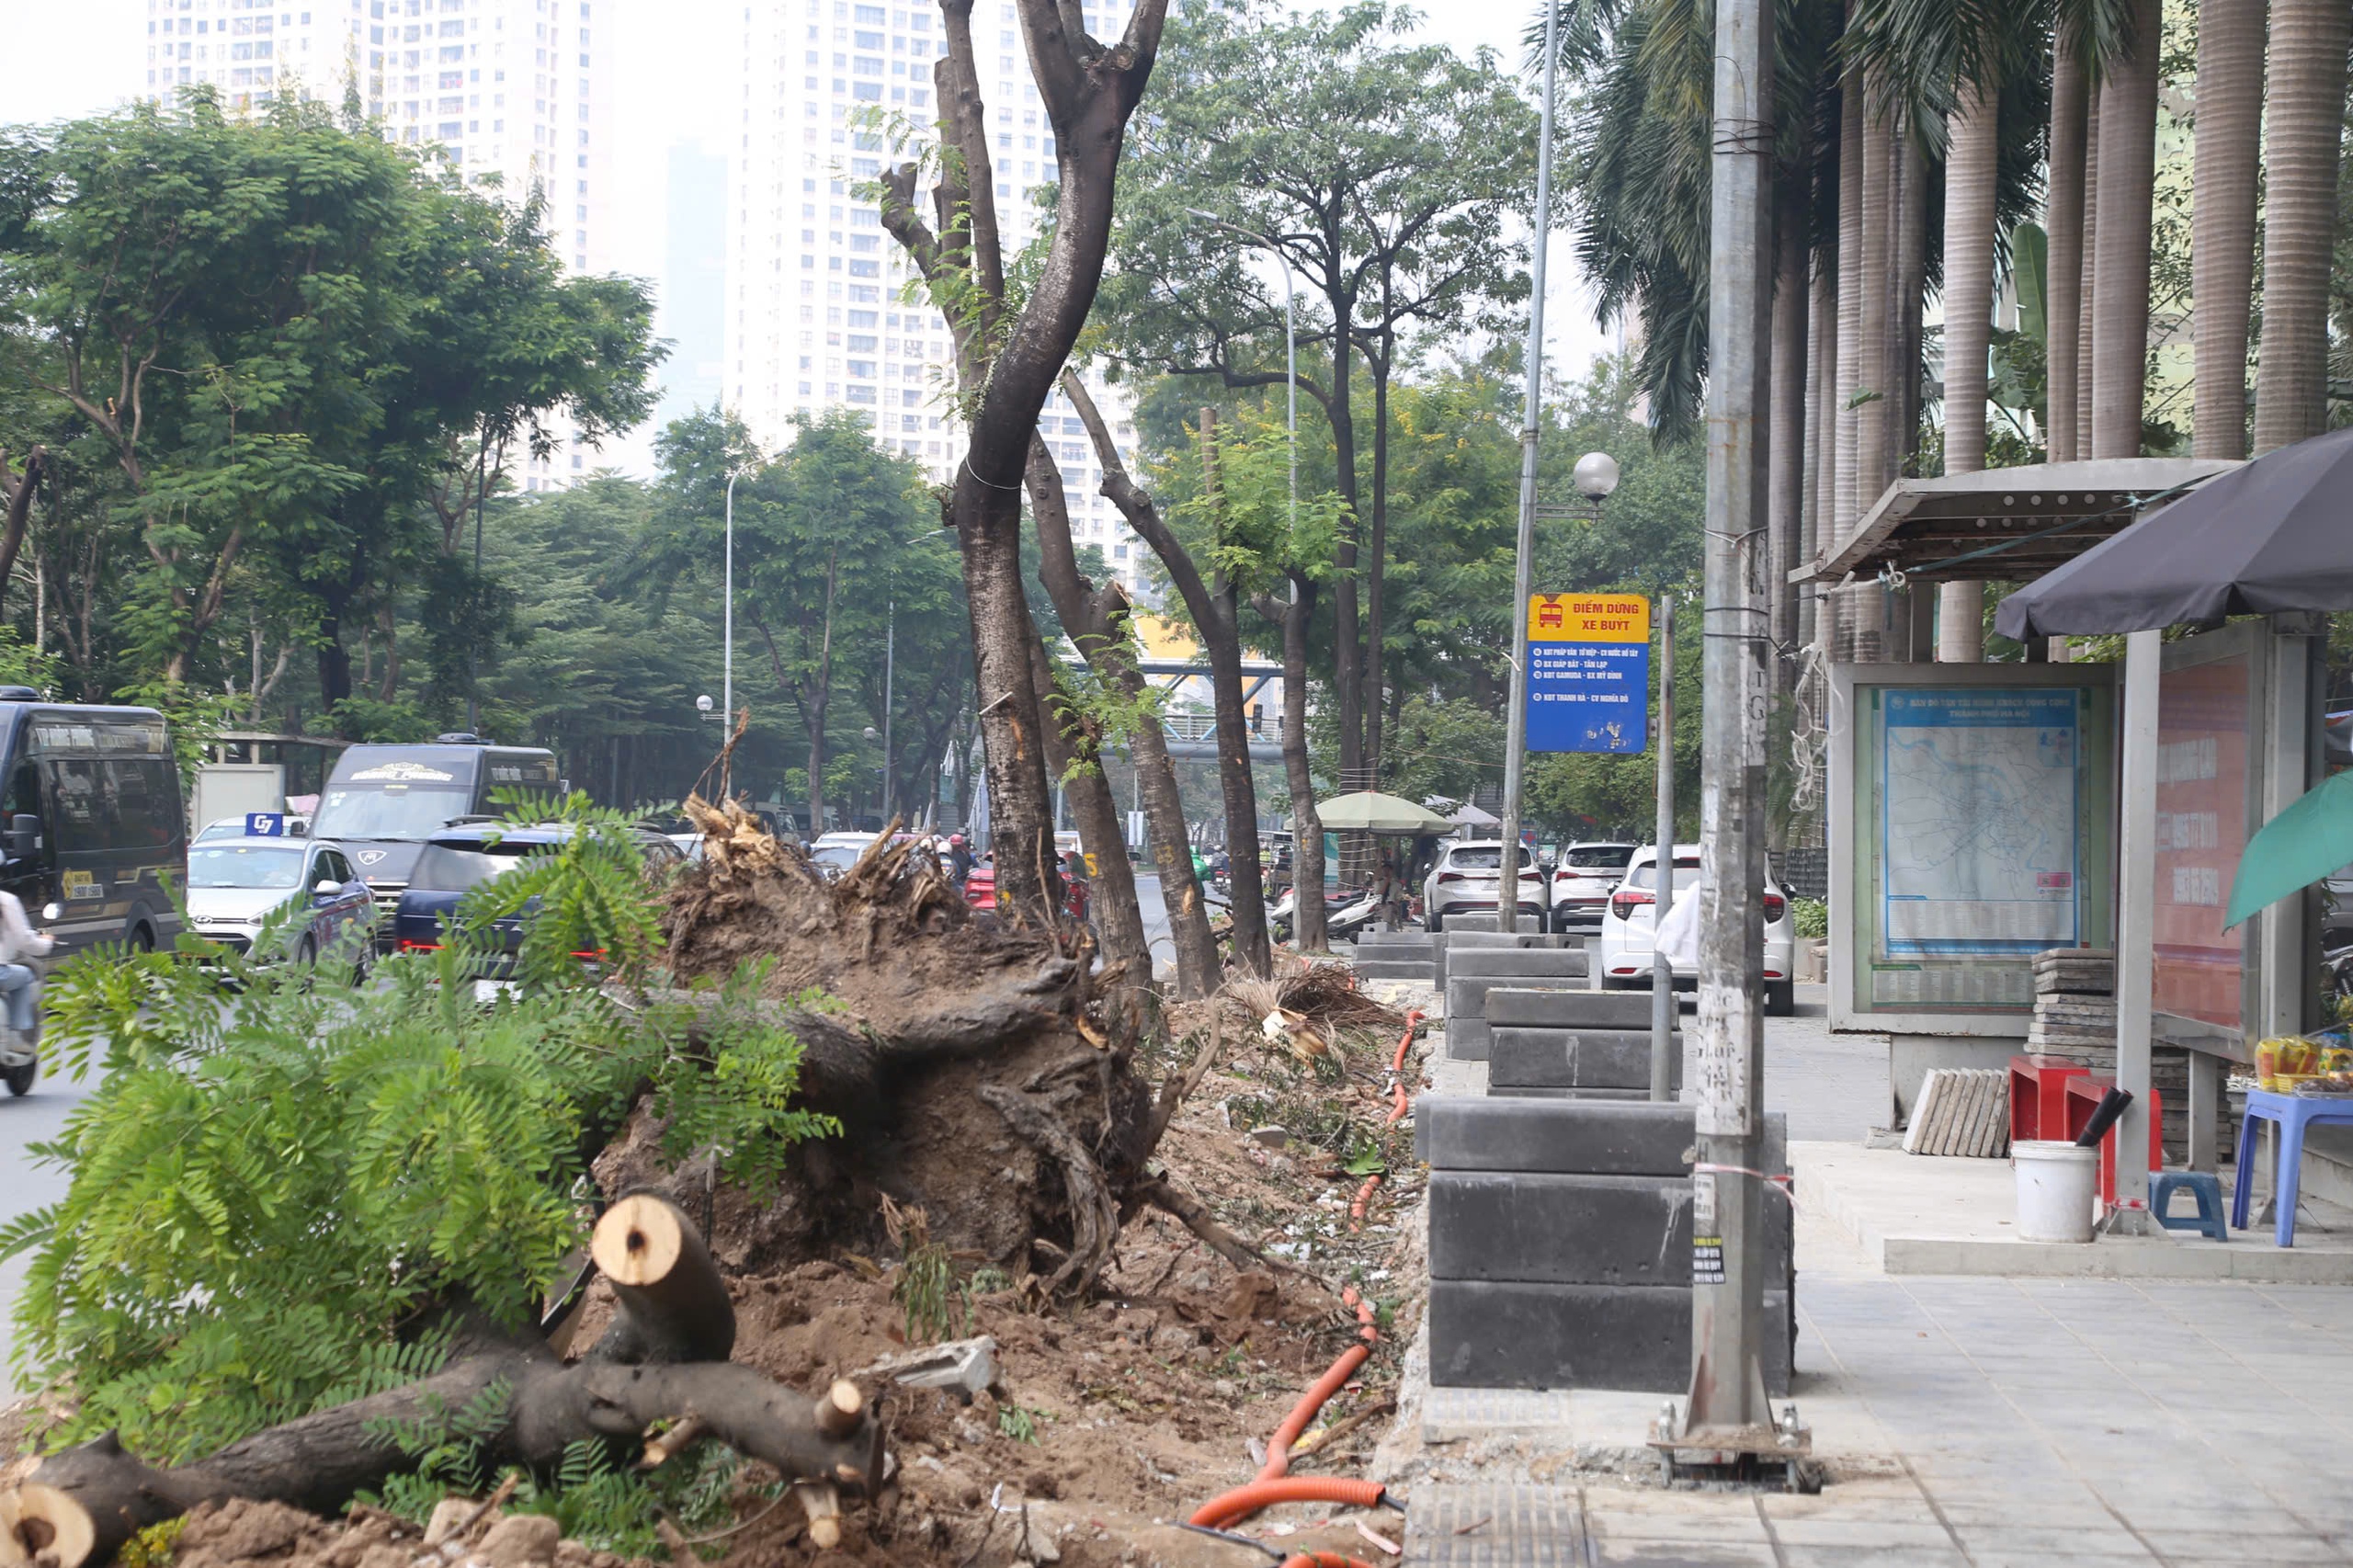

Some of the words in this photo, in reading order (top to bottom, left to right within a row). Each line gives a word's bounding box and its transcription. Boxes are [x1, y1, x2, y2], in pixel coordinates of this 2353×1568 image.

[1573, 600, 1603, 614] ĐIỂM
[1607, 602, 1639, 614] DỪNG
[1582, 620, 1597, 631] XE
[1600, 618, 1630, 631] BUÝT
[254, 814, 274, 834] G7
